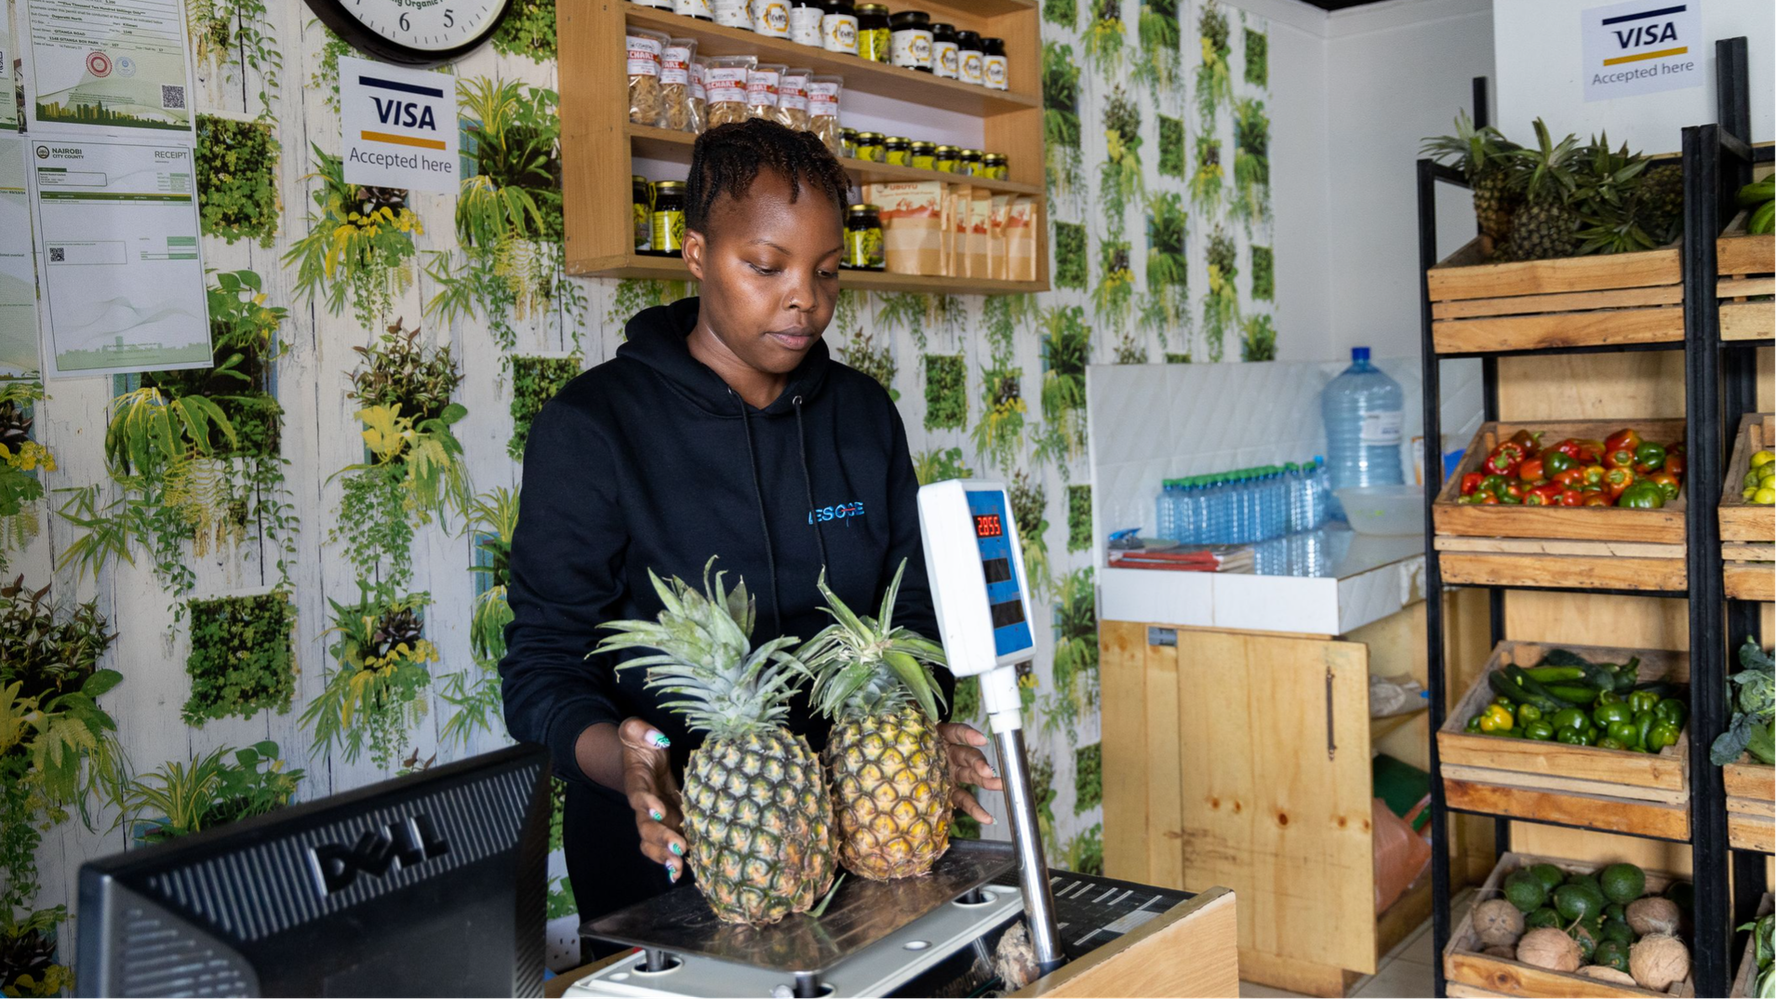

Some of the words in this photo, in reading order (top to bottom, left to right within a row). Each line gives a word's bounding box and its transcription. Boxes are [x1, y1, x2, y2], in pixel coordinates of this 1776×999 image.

[399, 12, 410, 32] 6
[443, 9, 454, 28] 5
[1611, 21, 1678, 49] VISA
[1591, 64, 1658, 86] Accepted
[1661, 61, 1695, 75] here
[368, 95, 437, 131] VISA
[154, 151, 187, 159] RECEIPT
[349, 147, 418, 170] Accepted
[421, 155, 452, 174] here
[310, 814, 450, 897] DELL
